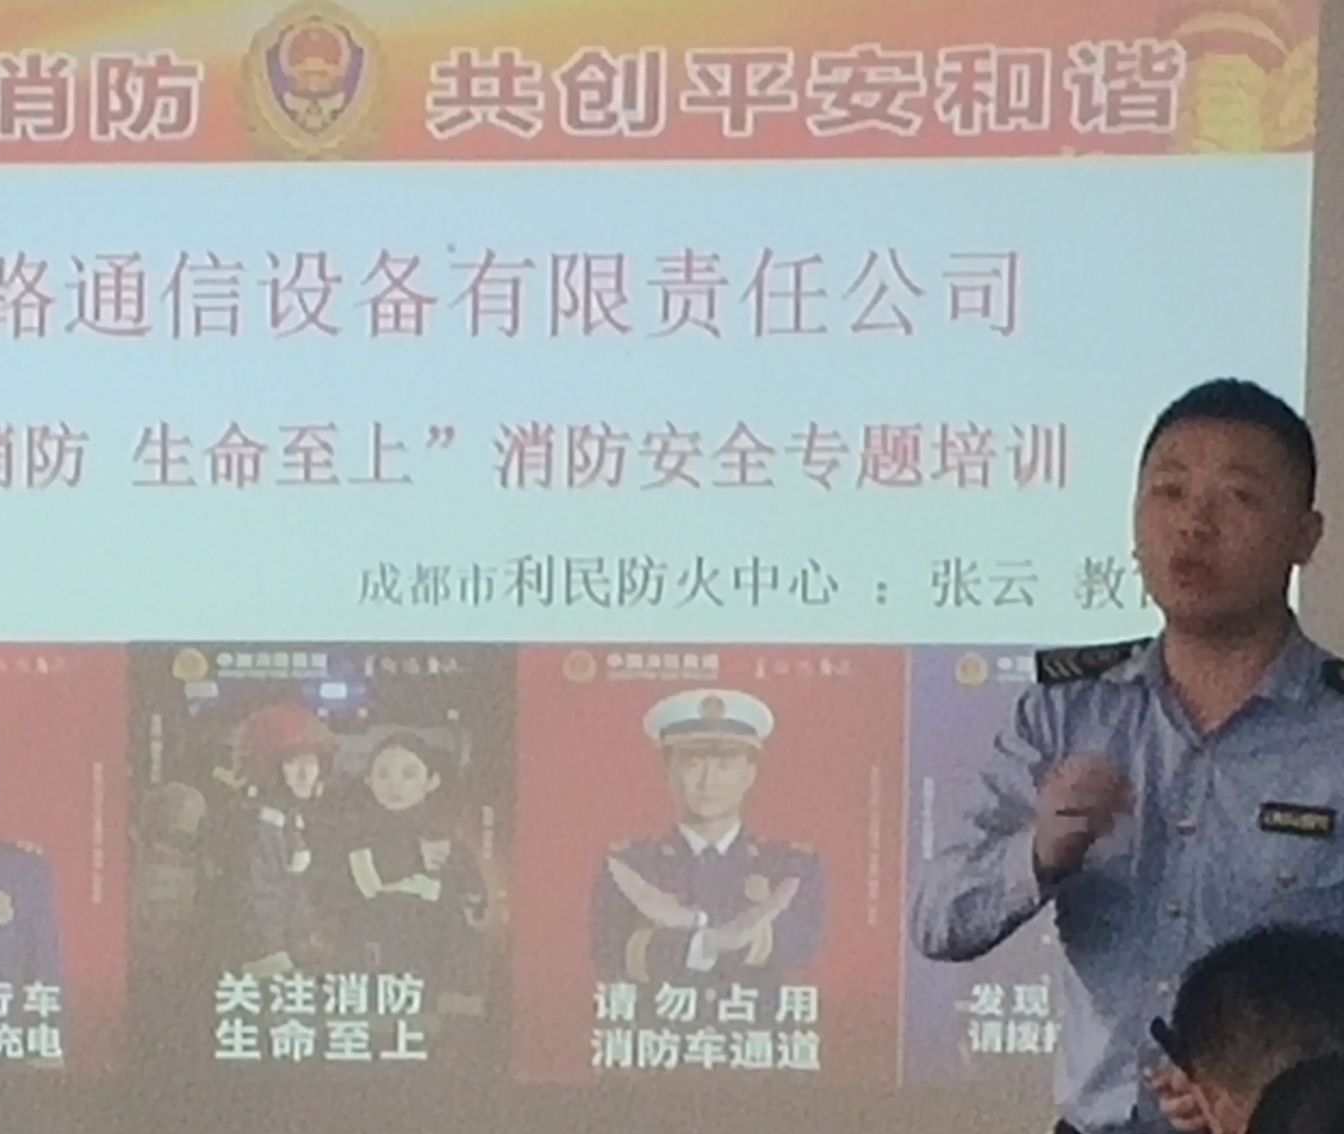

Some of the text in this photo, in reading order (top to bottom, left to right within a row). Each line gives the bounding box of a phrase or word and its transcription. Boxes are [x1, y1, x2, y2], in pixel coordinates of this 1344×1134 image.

[426, 38, 1190, 140] 共创平安和谐
[1074, 554, 1147, 610] 教
[214, 970, 426, 1014] 关注消防
[593, 980, 820, 1022] 请勿占用
[969, 982, 1051, 1018] 发现
[213, 1017, 429, 1063] 生命至上
[591, 1026, 822, 1072] 消防车通道
